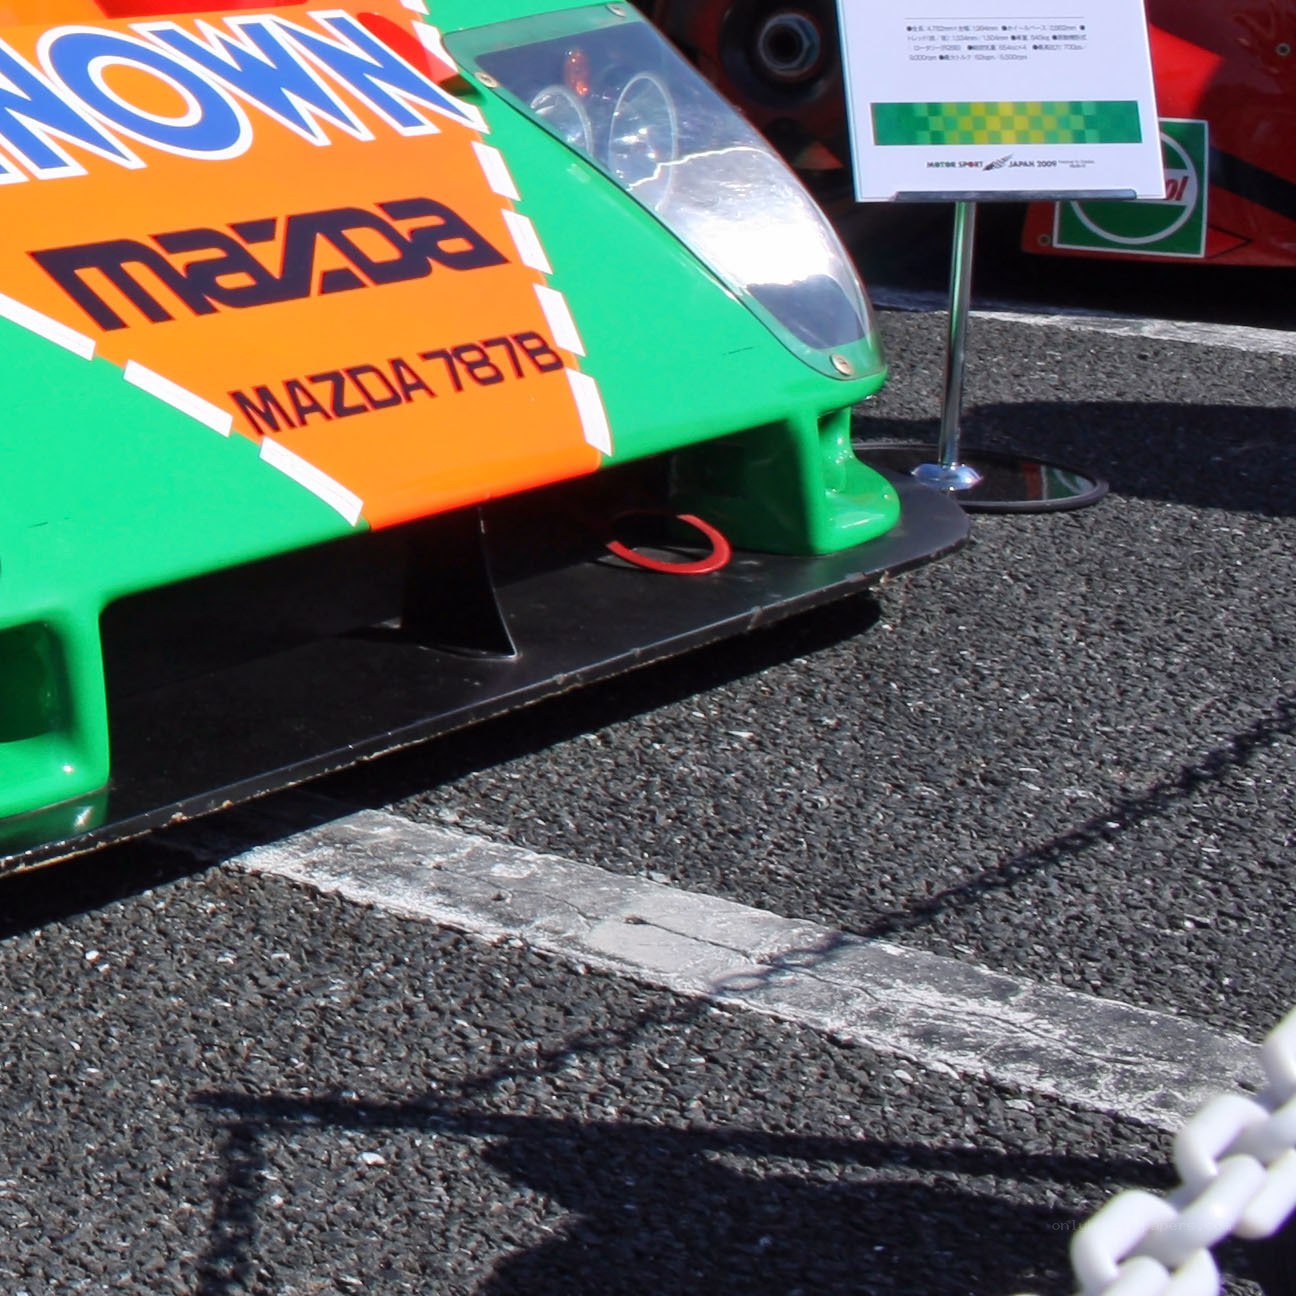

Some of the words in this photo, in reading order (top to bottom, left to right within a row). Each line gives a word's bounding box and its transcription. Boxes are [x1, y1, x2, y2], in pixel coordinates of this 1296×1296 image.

[1009, 159, 1035, 168] JAPAN
[1036, 160, 1058, 168] 2009
[227, 358, 439, 436] MAZDA
[421, 329, 566, 396] 787B
